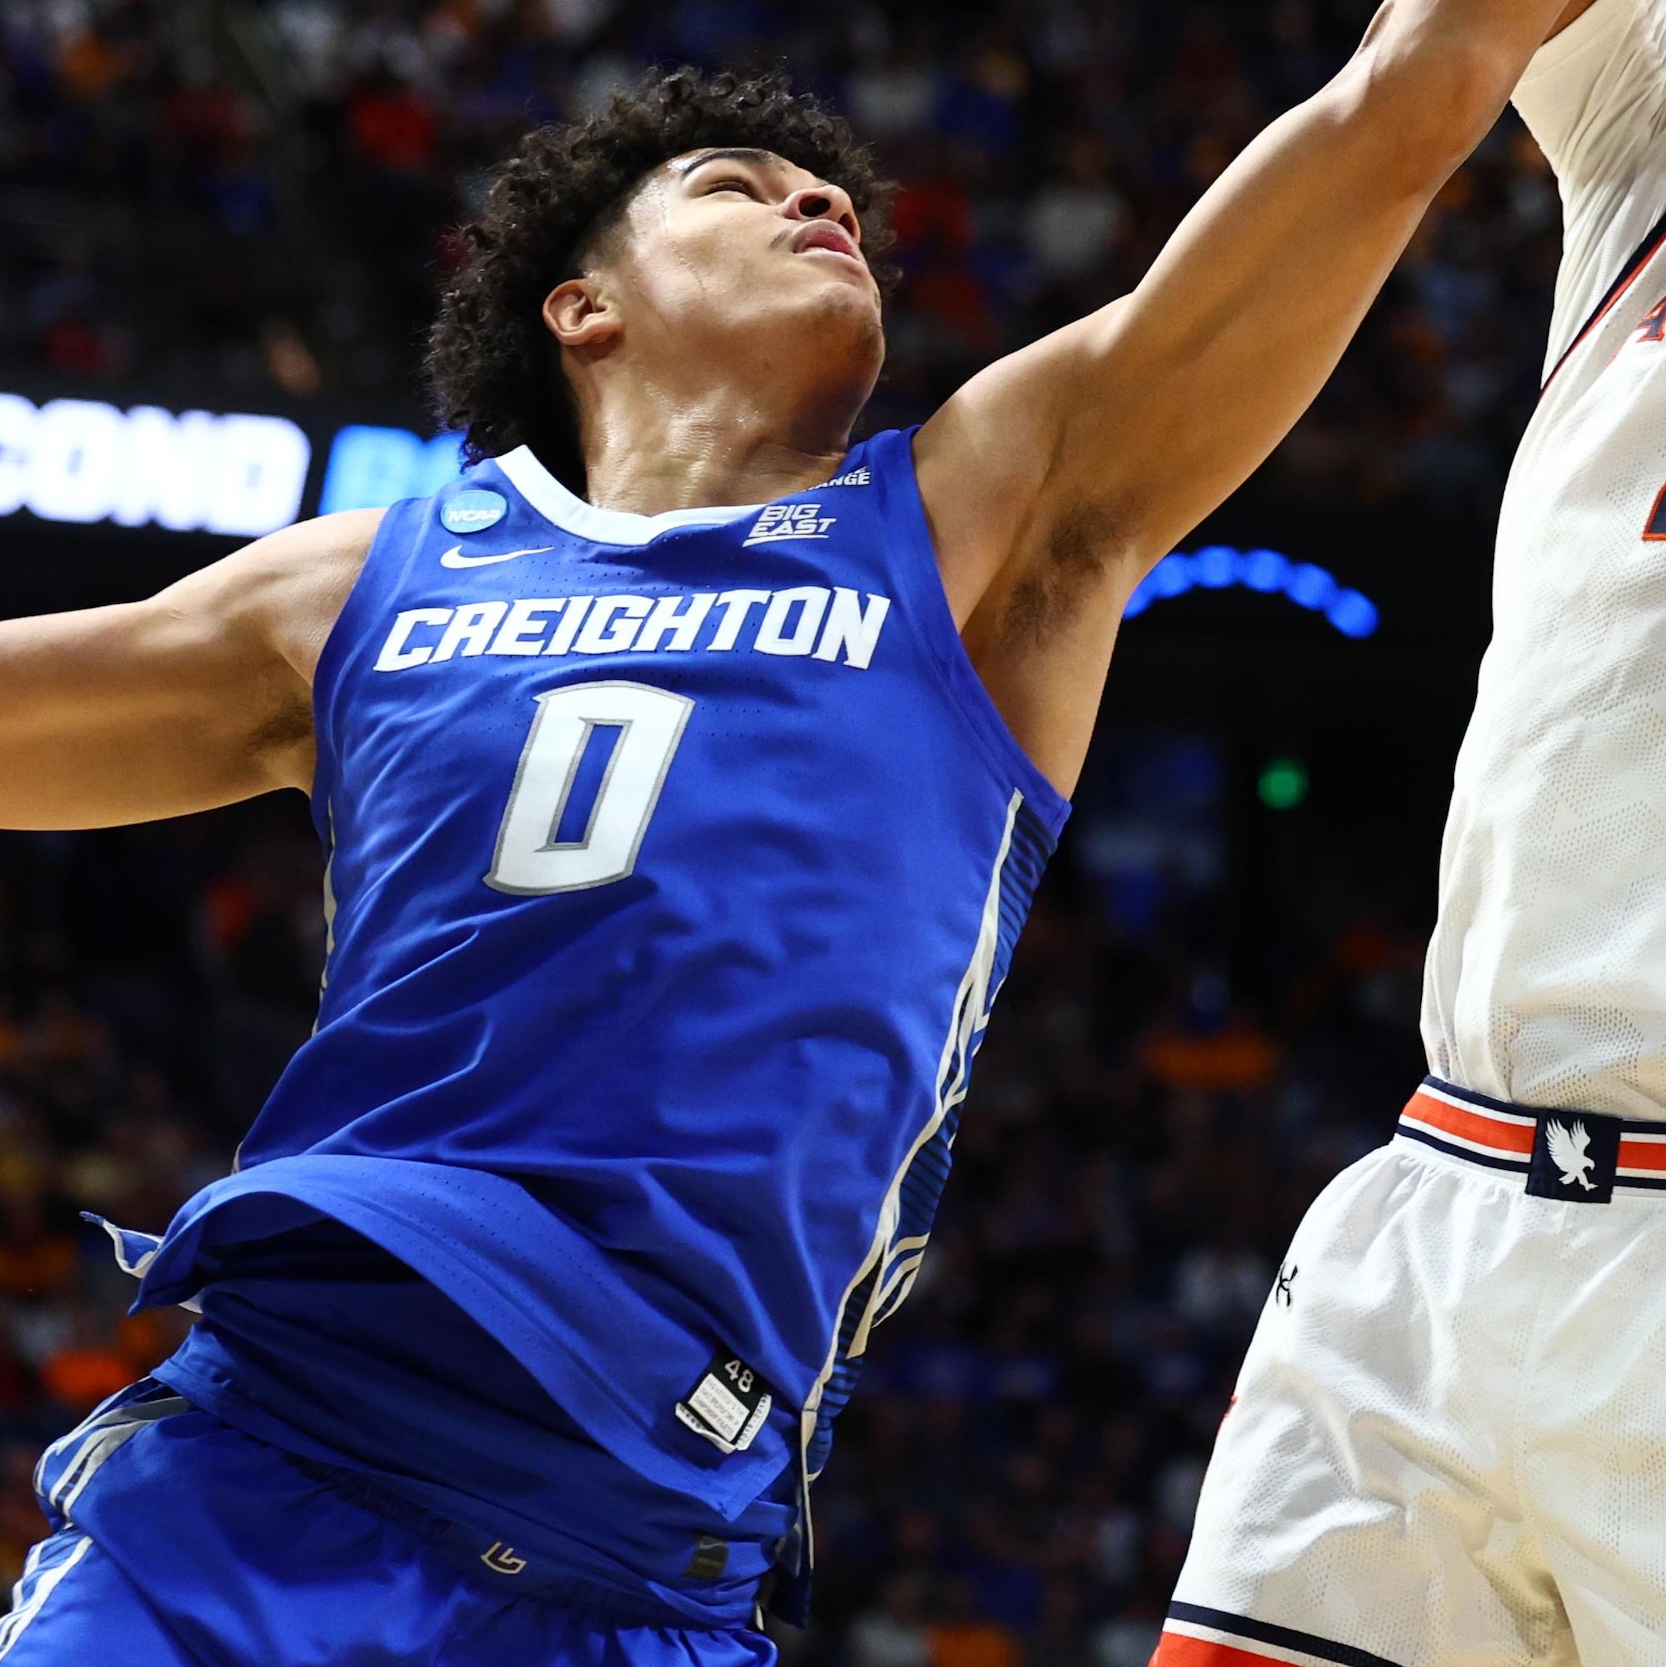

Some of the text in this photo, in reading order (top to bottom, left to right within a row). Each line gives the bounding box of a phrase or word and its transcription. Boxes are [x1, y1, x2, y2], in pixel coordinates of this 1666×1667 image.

[447, 509, 501, 523] NCAA
[758, 504, 822, 521] BIG
[748, 518, 837, 537] EAST
[373, 586, 890, 670] CREIGHTON
[482, 679, 696, 896] 0
[724, 1360, 754, 1393] 48
